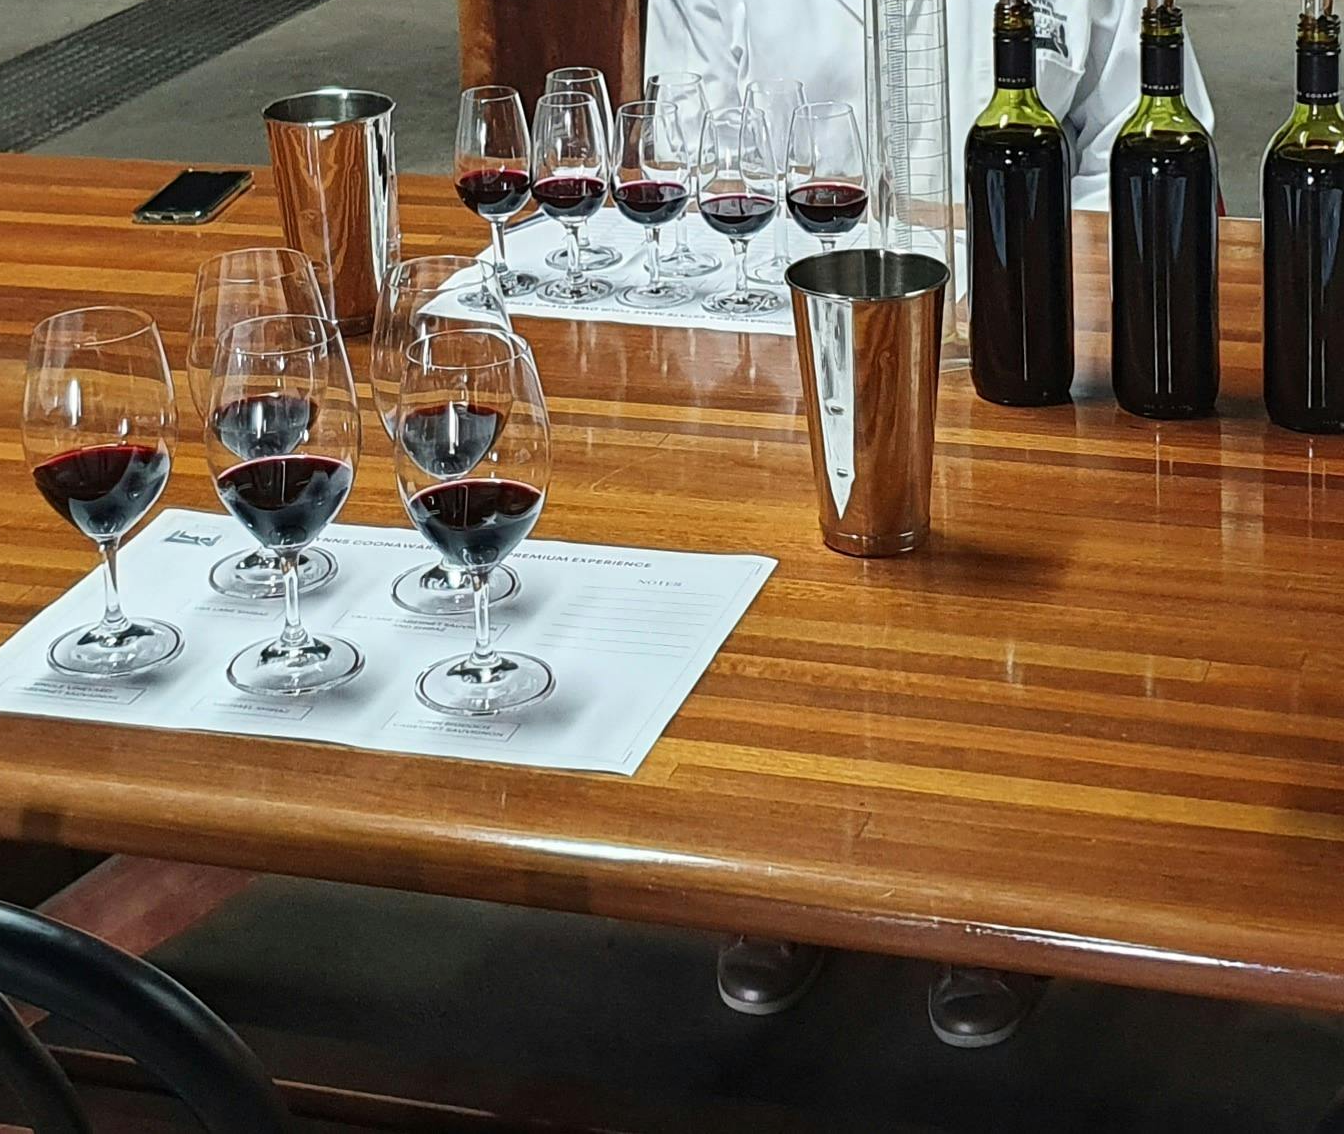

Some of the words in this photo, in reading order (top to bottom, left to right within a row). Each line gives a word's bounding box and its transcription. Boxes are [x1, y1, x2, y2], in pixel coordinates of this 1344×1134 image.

[315, 537, 353, 546] YNNS
[355, 539, 434, 552] COONAWAR
[571, 556, 653, 569] EXPERIENCE
